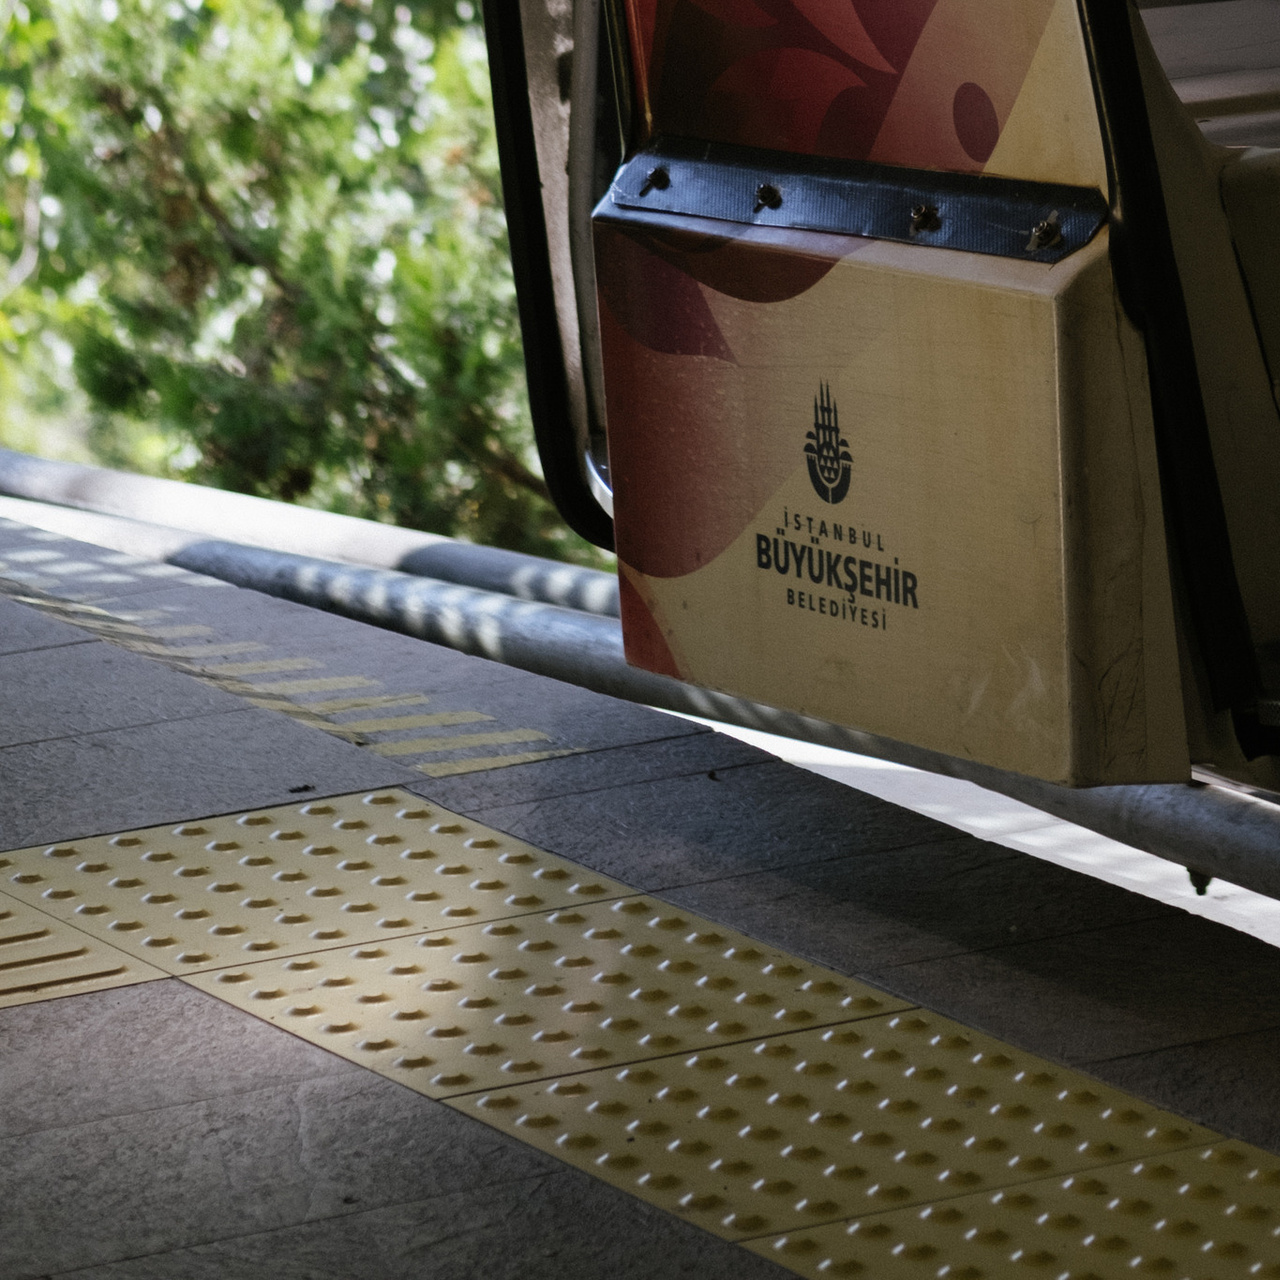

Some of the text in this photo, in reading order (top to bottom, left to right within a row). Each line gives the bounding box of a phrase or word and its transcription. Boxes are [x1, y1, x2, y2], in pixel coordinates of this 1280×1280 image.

[783, 506, 885, 552] İSTANBUL
[755, 527, 919, 609] BÜYÜKŞEHİR
[787, 588, 887, 630] BELEDİYESİ
